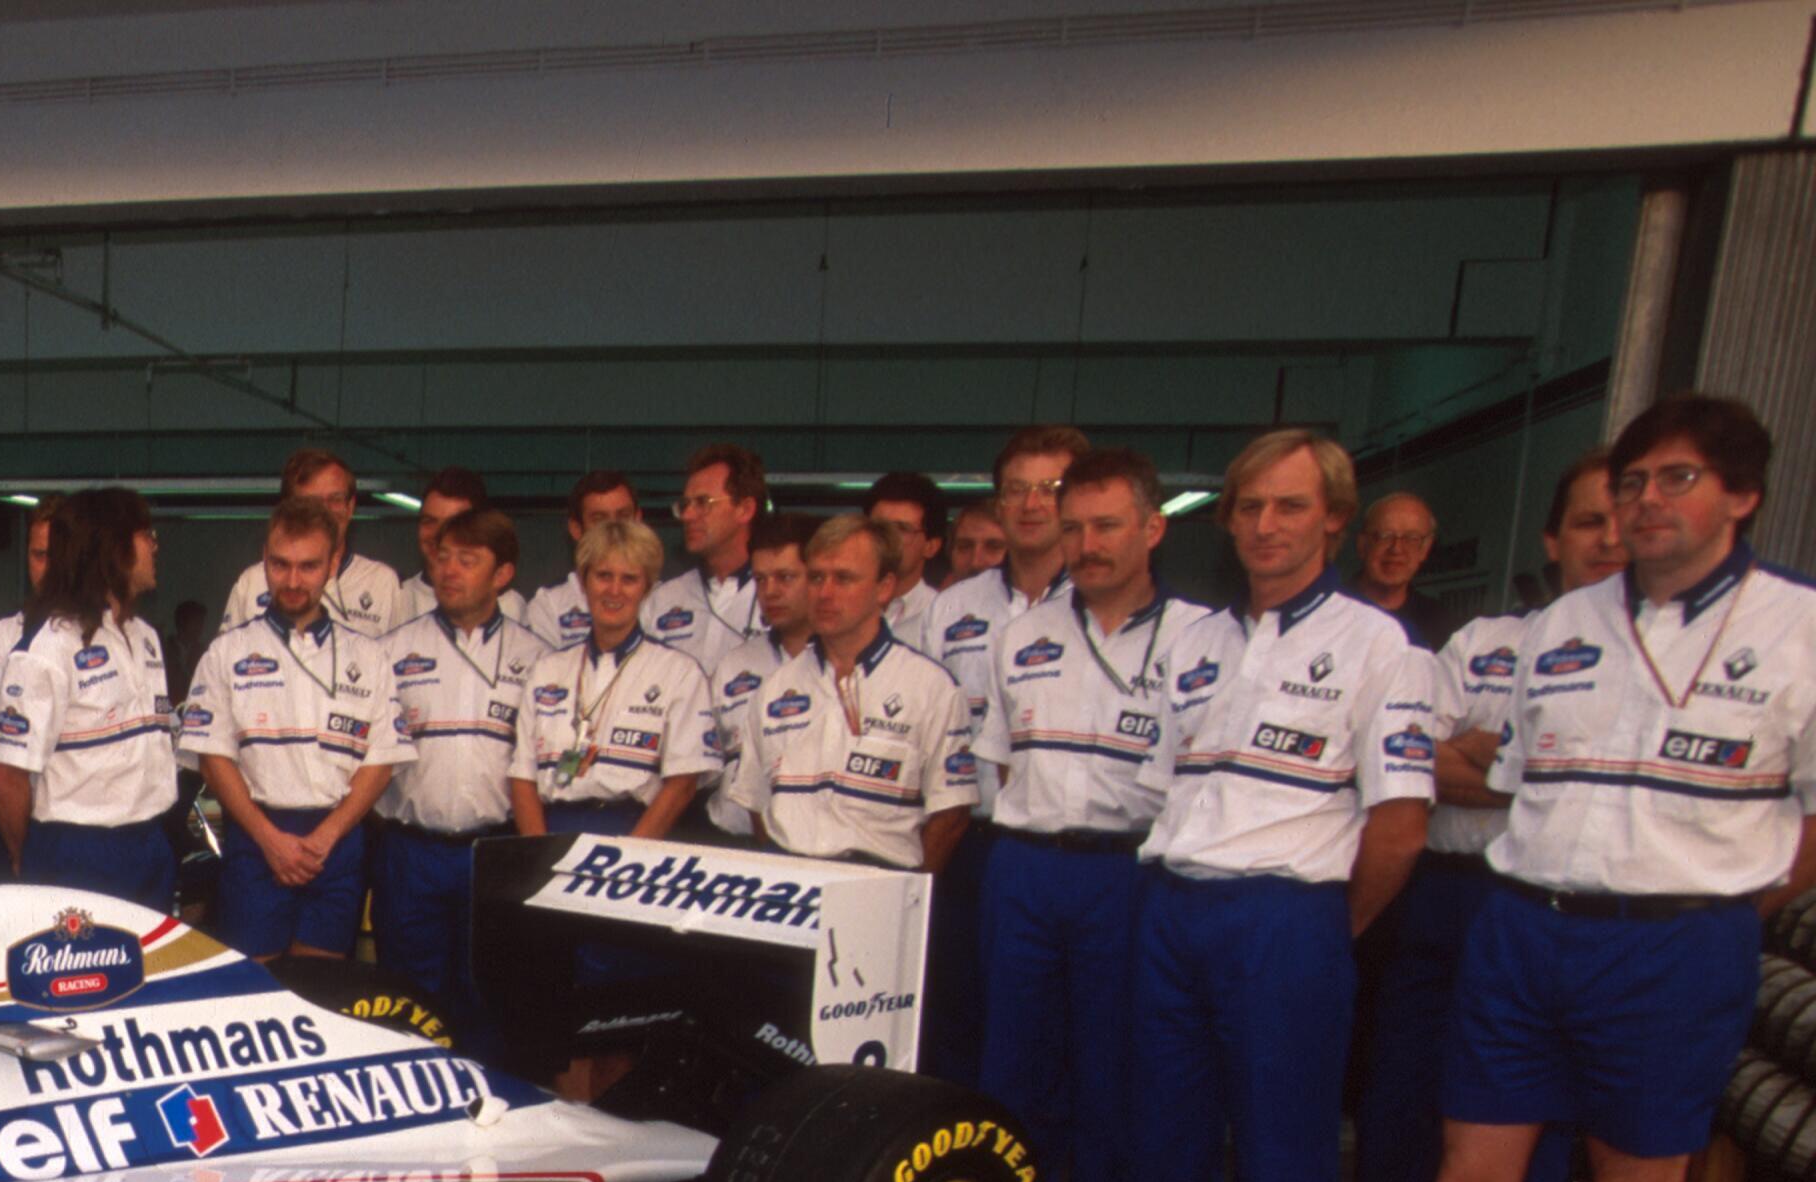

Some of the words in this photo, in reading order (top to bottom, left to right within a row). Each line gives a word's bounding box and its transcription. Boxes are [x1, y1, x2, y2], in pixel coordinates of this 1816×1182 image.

[1279, 680, 1344, 701] RENAULT
[329, 713, 355, 731] elf
[489, 702, 515, 721] elf
[1119, 712, 1157, 734] elf
[613, 728, 642, 746] elf
[1256, 727, 1301, 751] elf
[1664, 735, 1718, 762] elf
[848, 755, 883, 777] elf
[20, 942, 133, 977] Rothmans
[57, 976, 102, 994] RACING
[819, 991, 916, 1022] GOODYEAR
[234, 1057, 491, 1140] RENAULT
